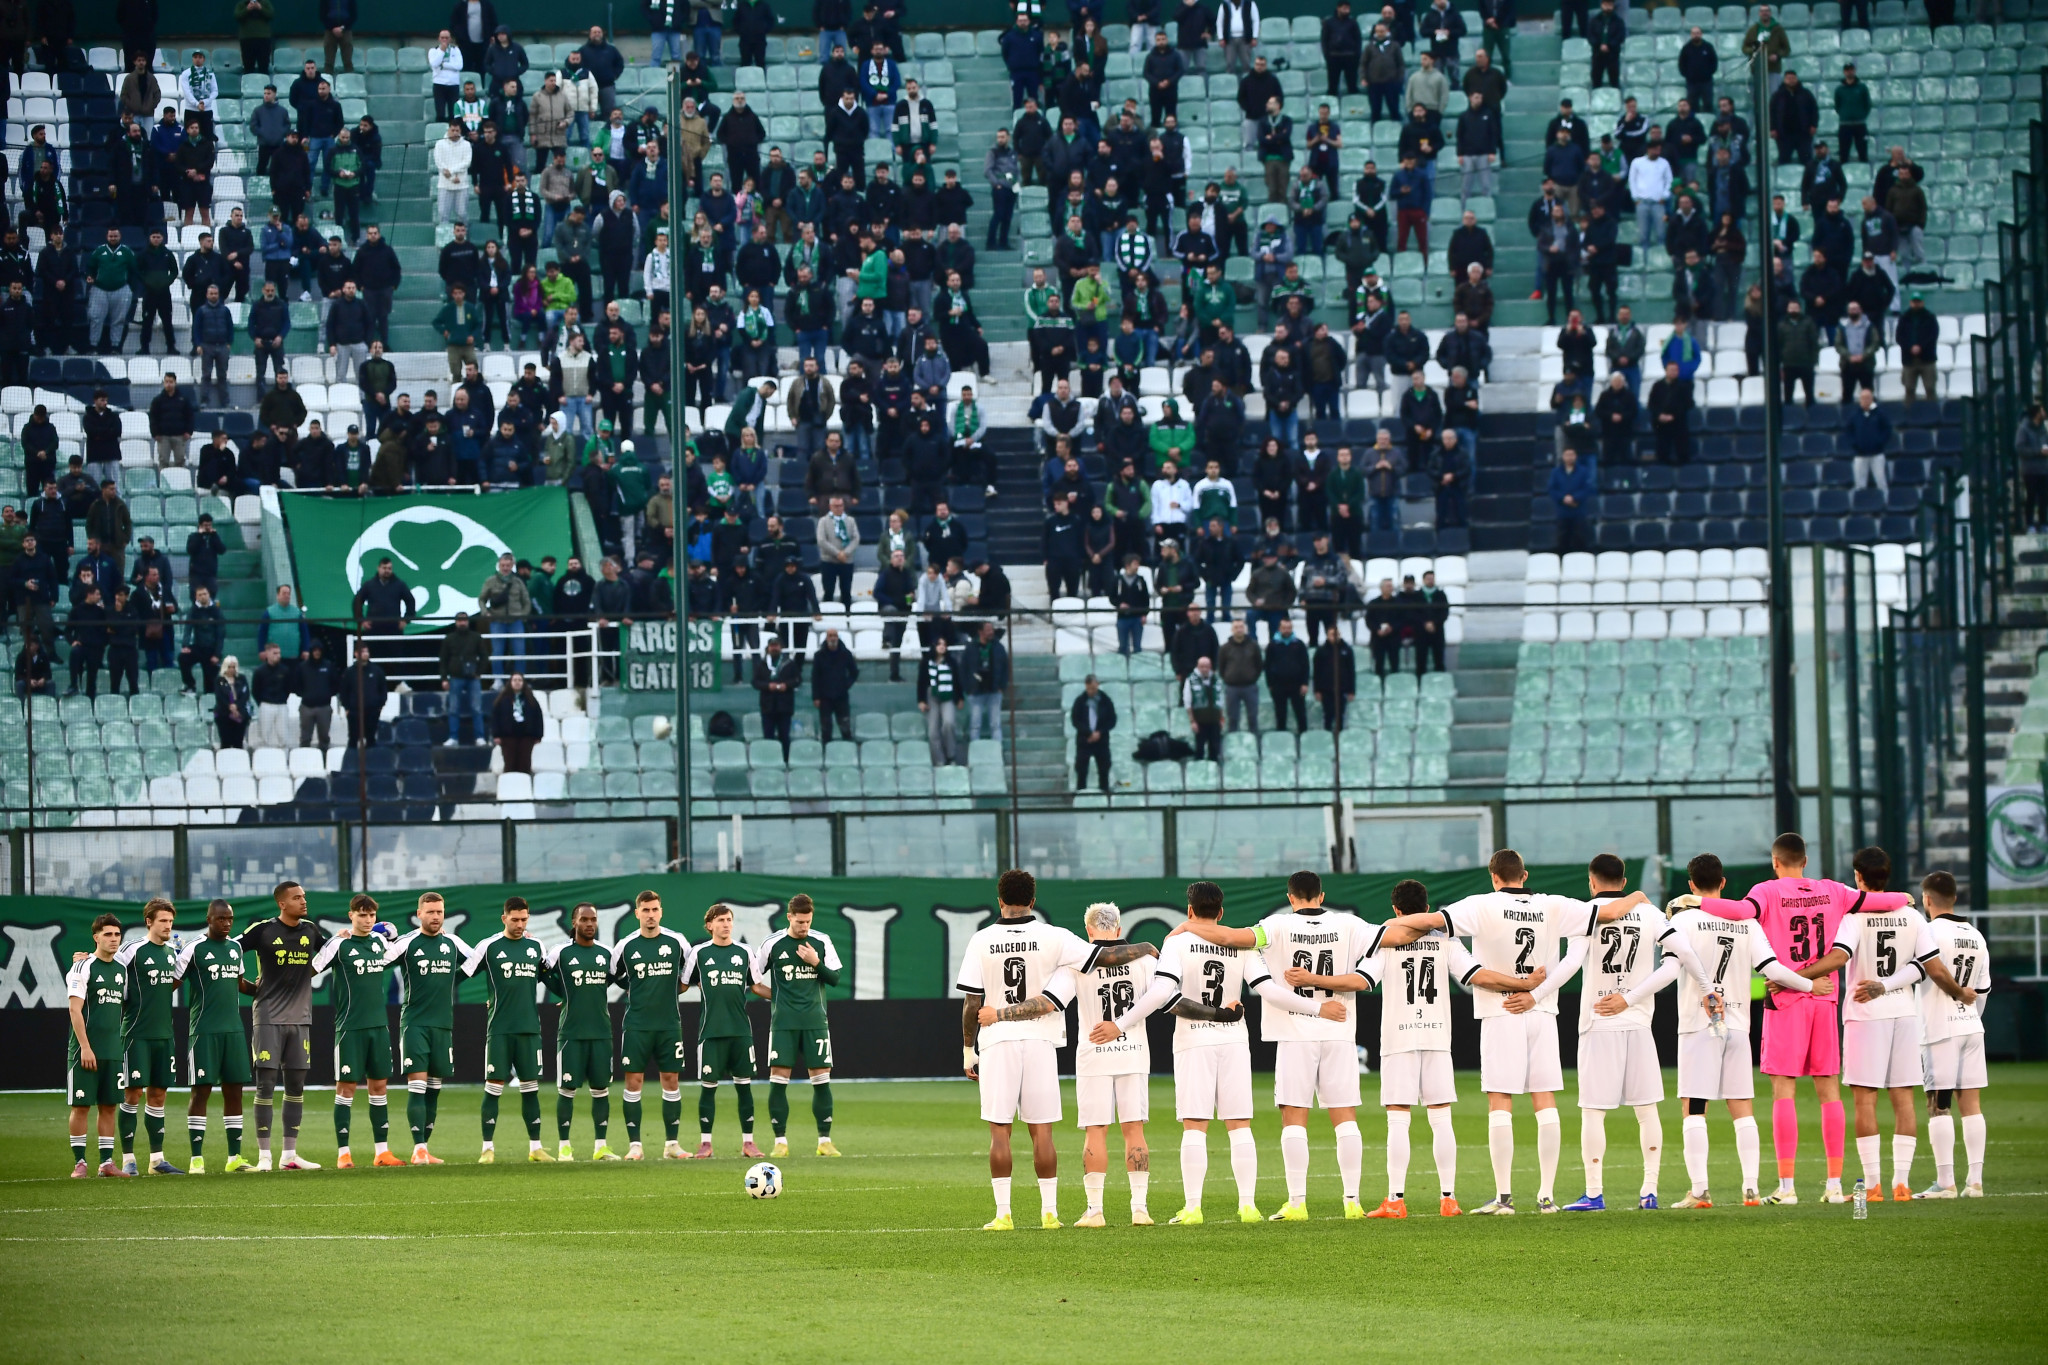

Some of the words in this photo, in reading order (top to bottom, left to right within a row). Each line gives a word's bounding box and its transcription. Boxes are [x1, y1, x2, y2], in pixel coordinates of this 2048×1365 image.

[691, 662, 713, 689] 13
[989, 942, 1027, 954] SALCEDO
[1028, 941, 1040, 951] JR.
[1190, 944, 1238, 958] ATHANASIOU
[1515, 927, 1535, 974] 2
[1600, 926, 1640, 974] 27
[1712, 936, 1735, 984] 7
[1789, 912, 1825, 962] 31
[1877, 930, 1897, 977] 5
[1003, 957, 1027, 1004] 9
[1097, 969, 1105, 979] T.
[1105, 965, 1130, 978] NUSS
[1201, 960, 1225, 1008] 3
[1292, 949, 1334, 998] 24
[1401, 957, 1438, 1005] 14
[1953, 954, 1976, 988] 11
[1097, 980, 1135, 1021] 18
[1095, 1044, 1143, 1053] BIANCHT
